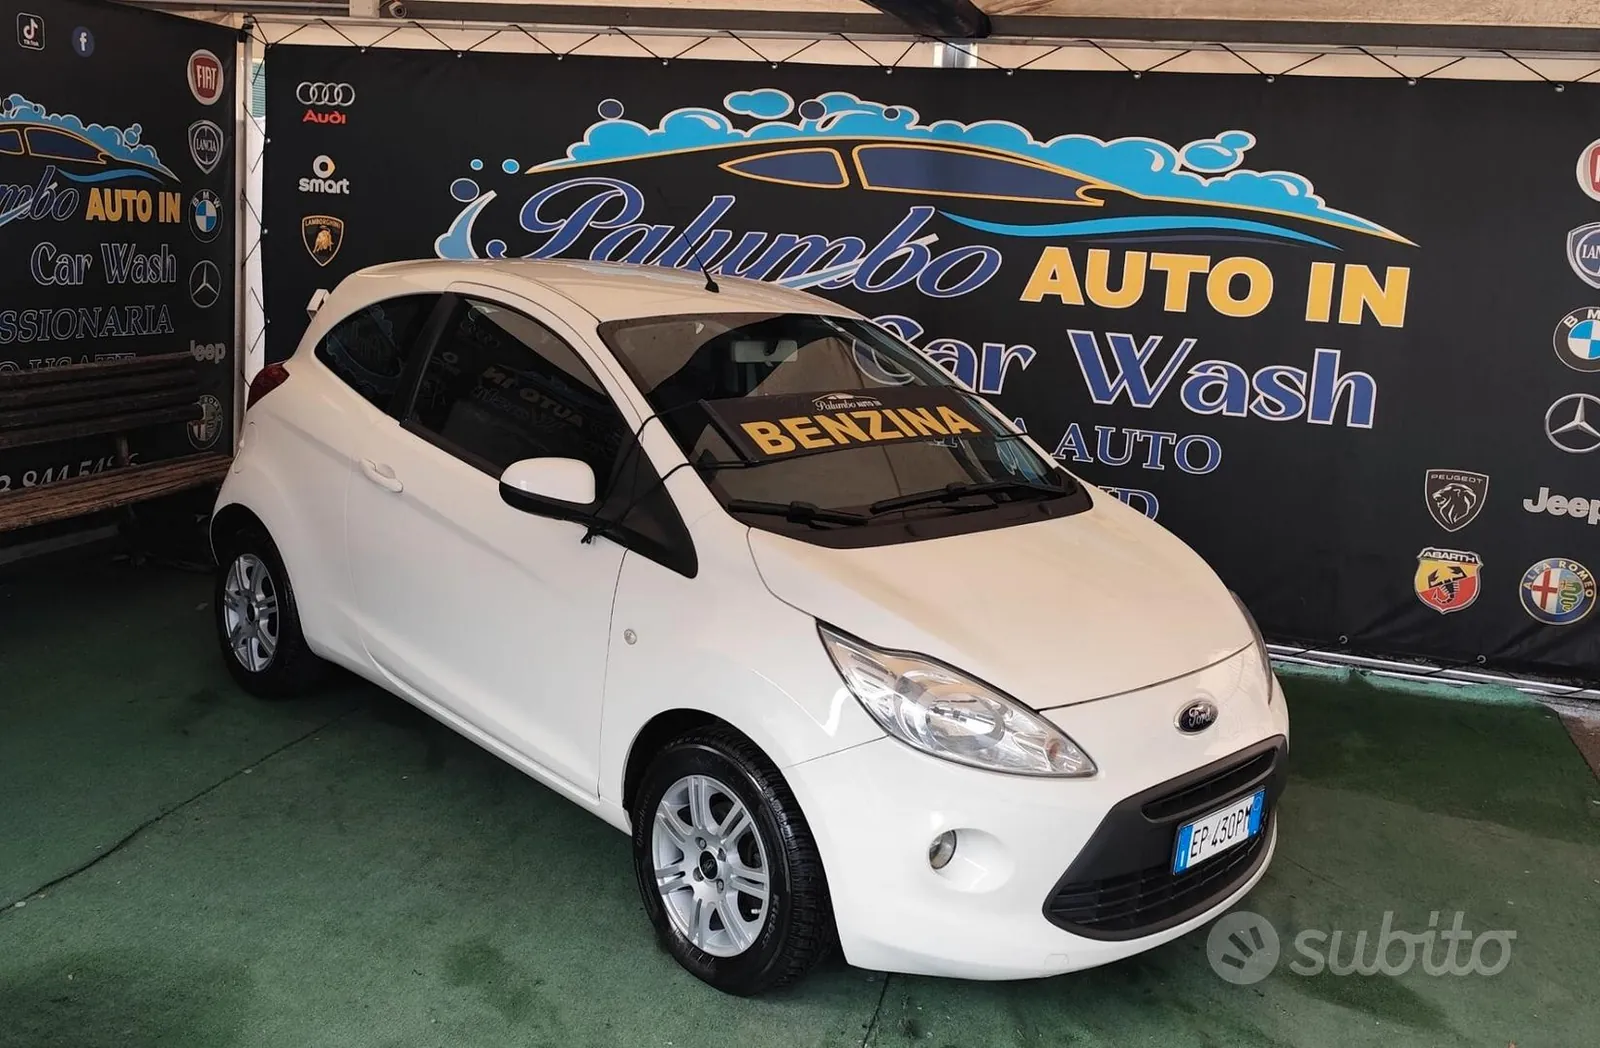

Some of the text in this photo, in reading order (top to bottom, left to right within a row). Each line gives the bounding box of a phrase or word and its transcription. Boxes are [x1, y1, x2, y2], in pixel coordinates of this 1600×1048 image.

[196, 64, 218, 91] FIAT
[302, 109, 346, 124] Audi
[195, 138, 217, 152] LANCIA
[192, 191, 221, 208] BMW
[298, 178, 350, 194] smart
[85, 187, 152, 223] AUTO
[158, 191, 181, 223] IN
[30, 241, 177, 286] Car Wash
[519, 177, 1411, 328] Palumbo AUTO IN
[853, 315, 1378, 430] Car Wash
[815, 400, 856, 412] Palumbo
[740, 406, 982, 455] BENZINA
[1051, 422, 1222, 475] AUTO
[1431, 474, 1483, 484] PEUGEOT
[1423, 551, 1475, 563] ABARTH
[1523, 560, 1594, 599] ALFA ROMEO
[1188, 706, 1211, 728] Ford
[1190, 826, 1209, 858] EP
